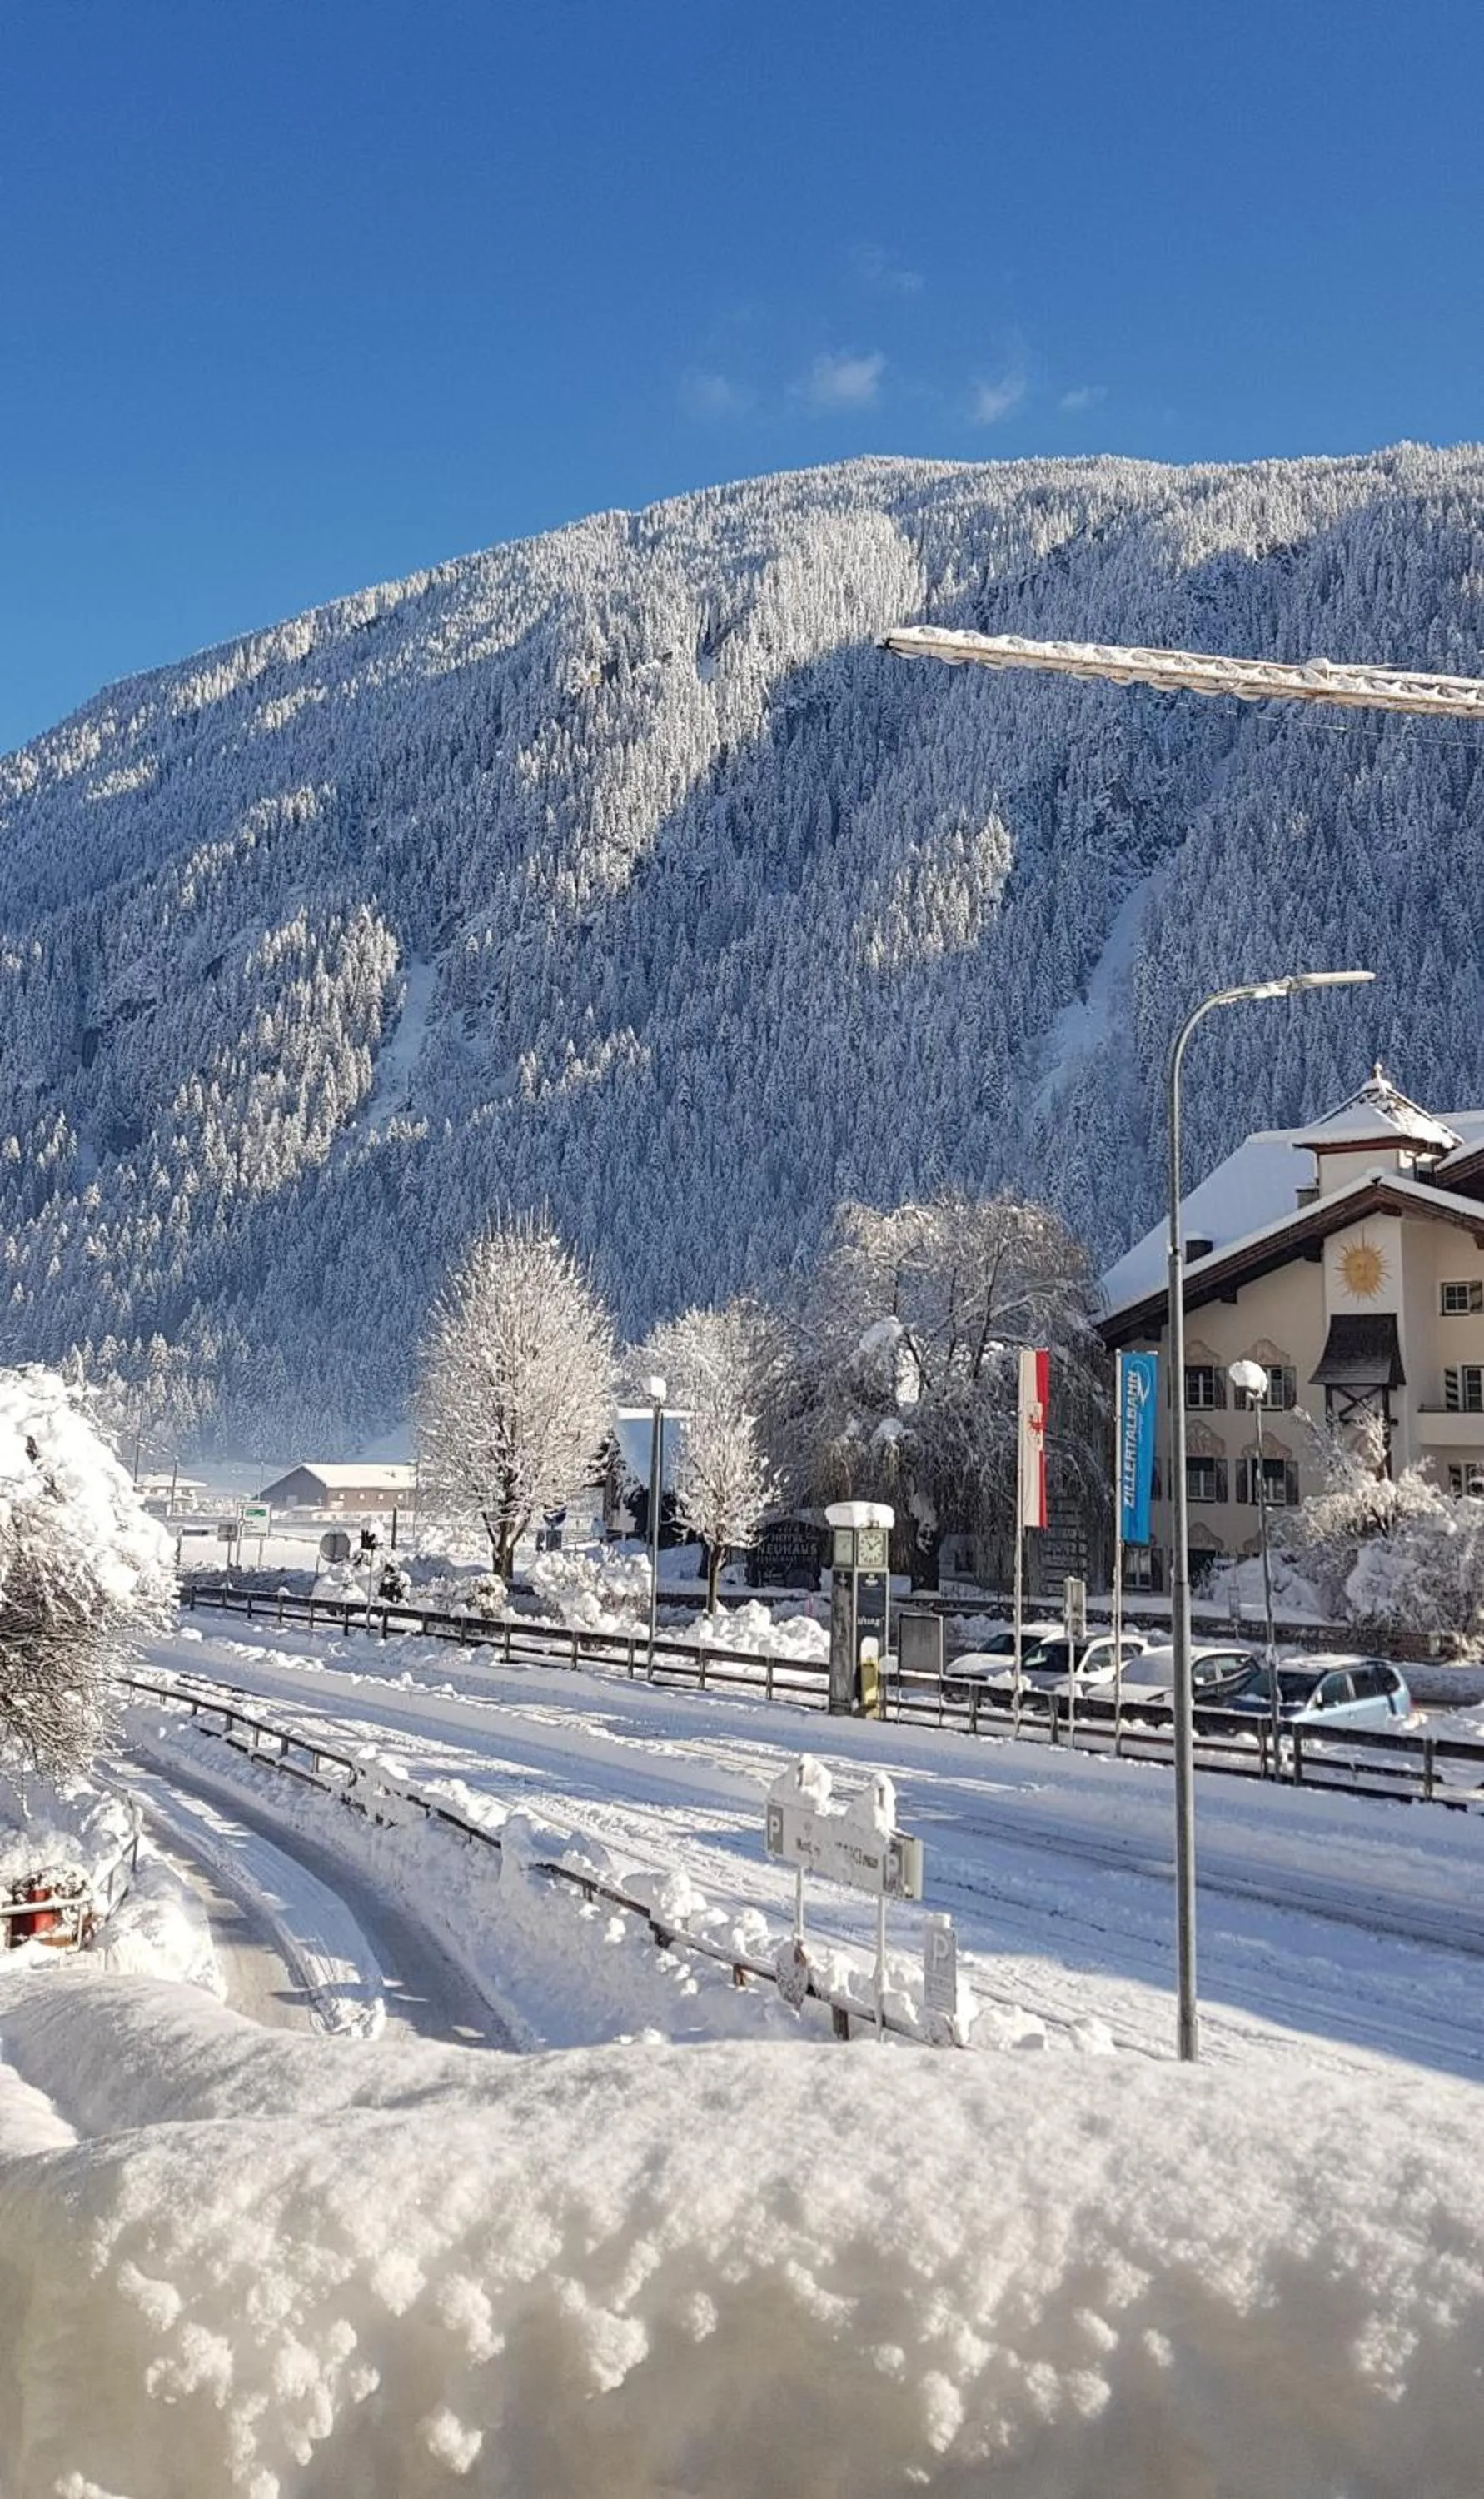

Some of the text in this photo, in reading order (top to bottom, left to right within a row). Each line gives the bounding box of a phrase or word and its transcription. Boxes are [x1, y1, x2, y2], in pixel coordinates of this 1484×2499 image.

[1123, 1370, 1140, 1509] ZILLERTALBAHN
[758, 1543, 818, 1556] NEUHAUS
[769, 1814, 781, 1853] P
[885, 1853, 900, 1884] P
[933, 1933, 949, 1972] P
